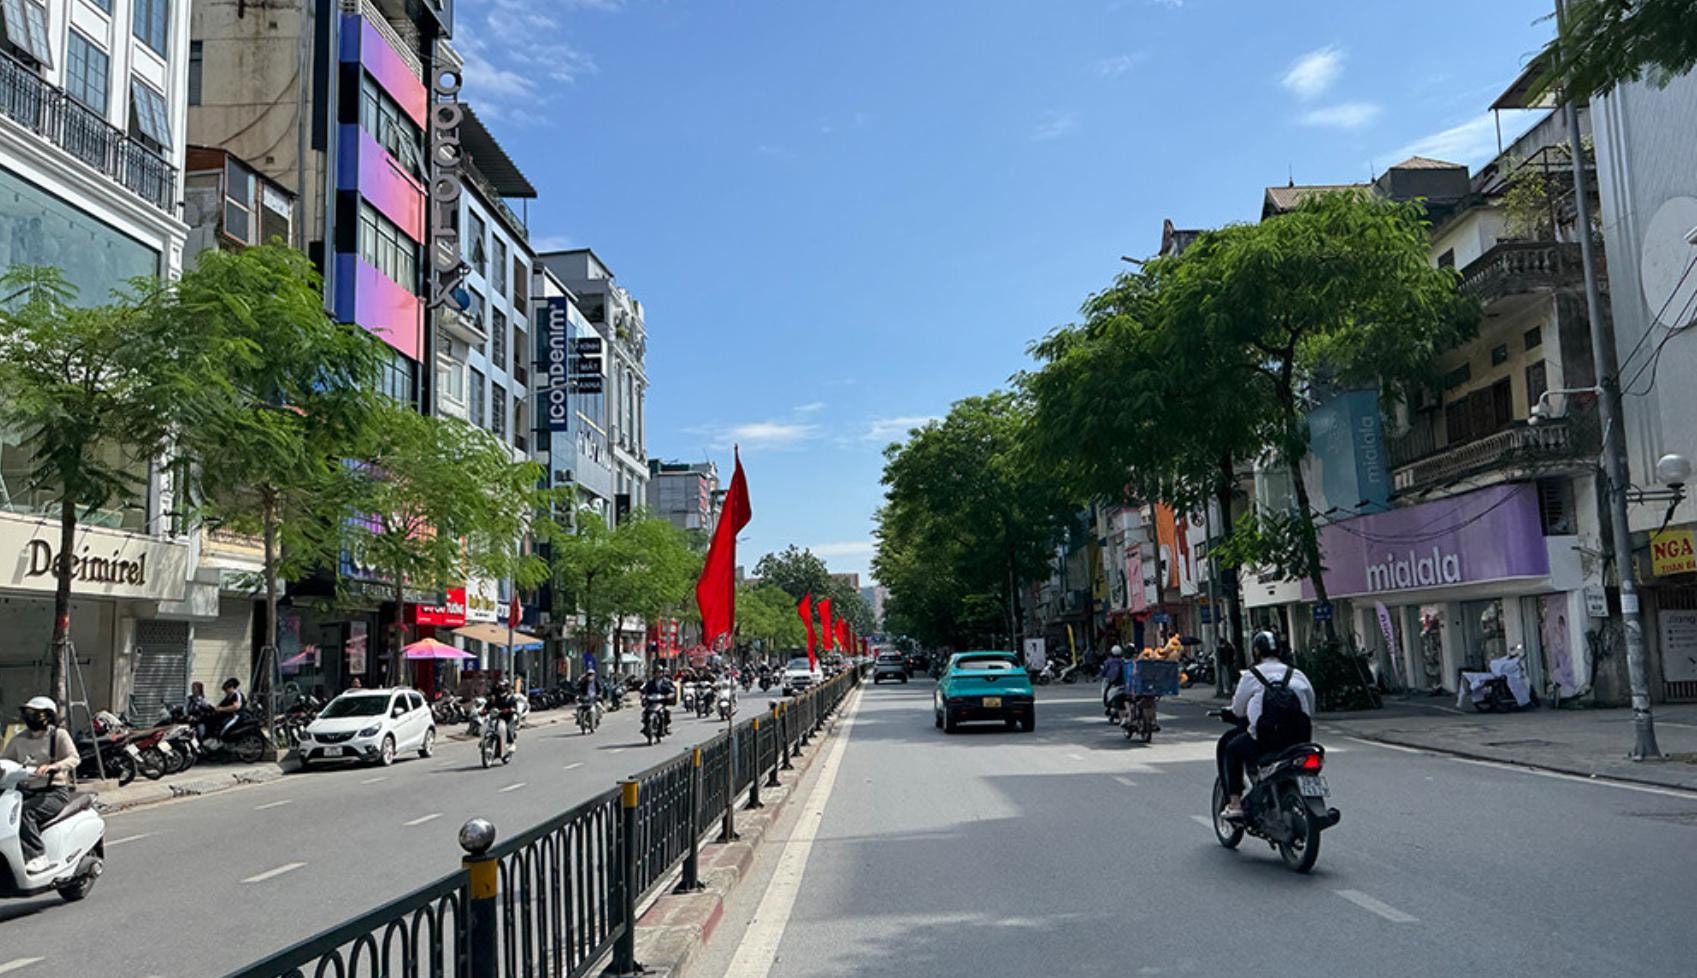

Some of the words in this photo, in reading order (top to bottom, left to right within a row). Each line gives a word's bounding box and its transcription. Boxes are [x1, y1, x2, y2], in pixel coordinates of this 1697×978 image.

[1358, 416, 1380, 482] mialala
[1366, 545, 1462, 592] mialala
[1653, 537, 1694, 561] NGA
